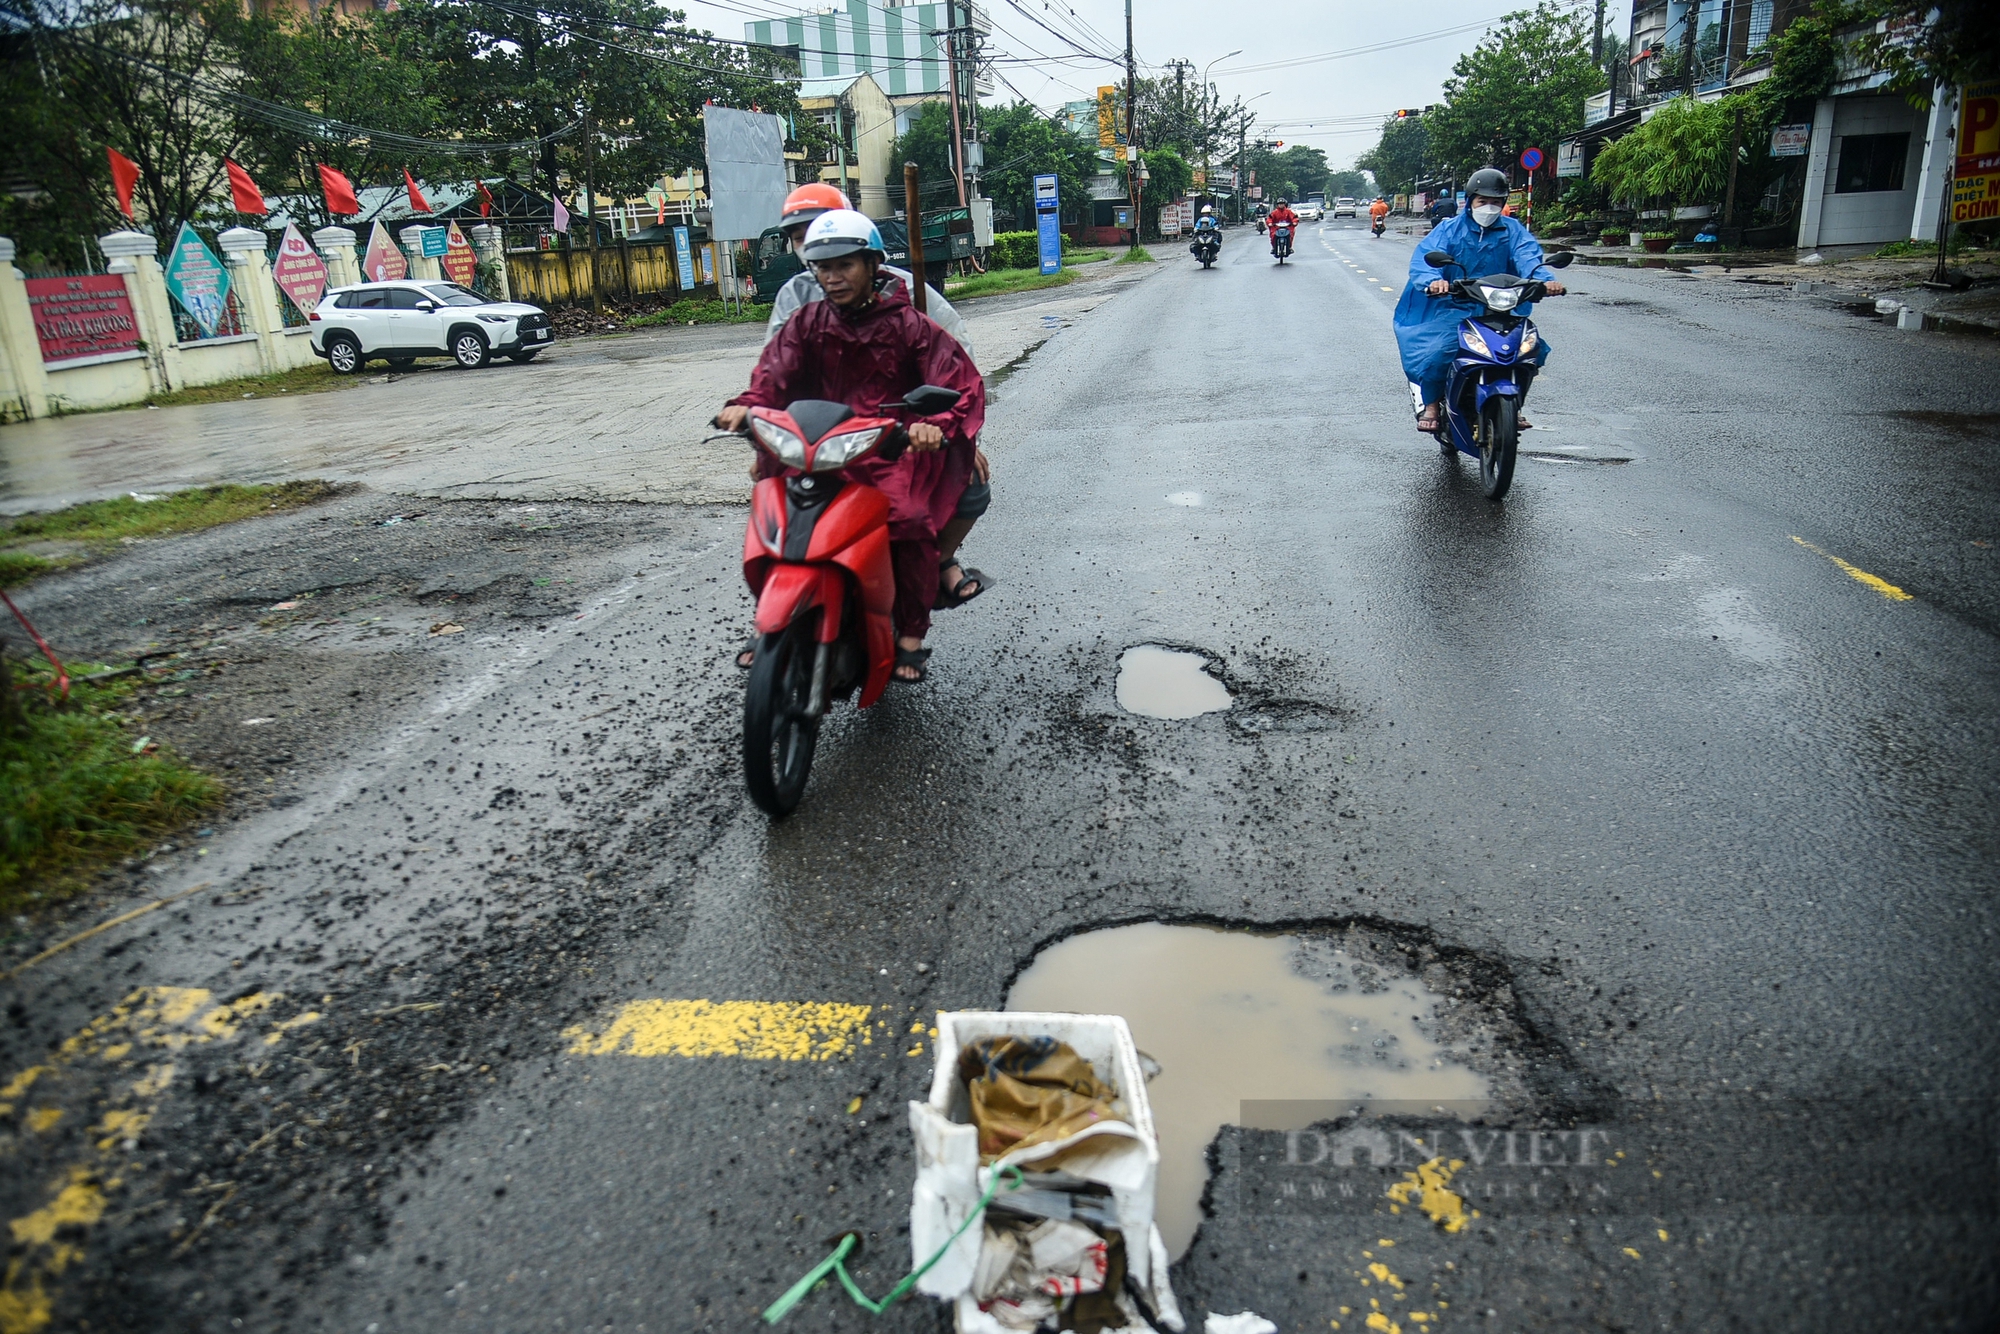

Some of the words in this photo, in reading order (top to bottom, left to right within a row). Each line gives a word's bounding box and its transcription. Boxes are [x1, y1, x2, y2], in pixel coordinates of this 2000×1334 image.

[1956, 178, 1984, 189] ĐẶC
[1954, 190, 1985, 202] BIỆT
[1955, 199, 1998, 221] CƠM
[57, 315, 85, 338] HÒA
